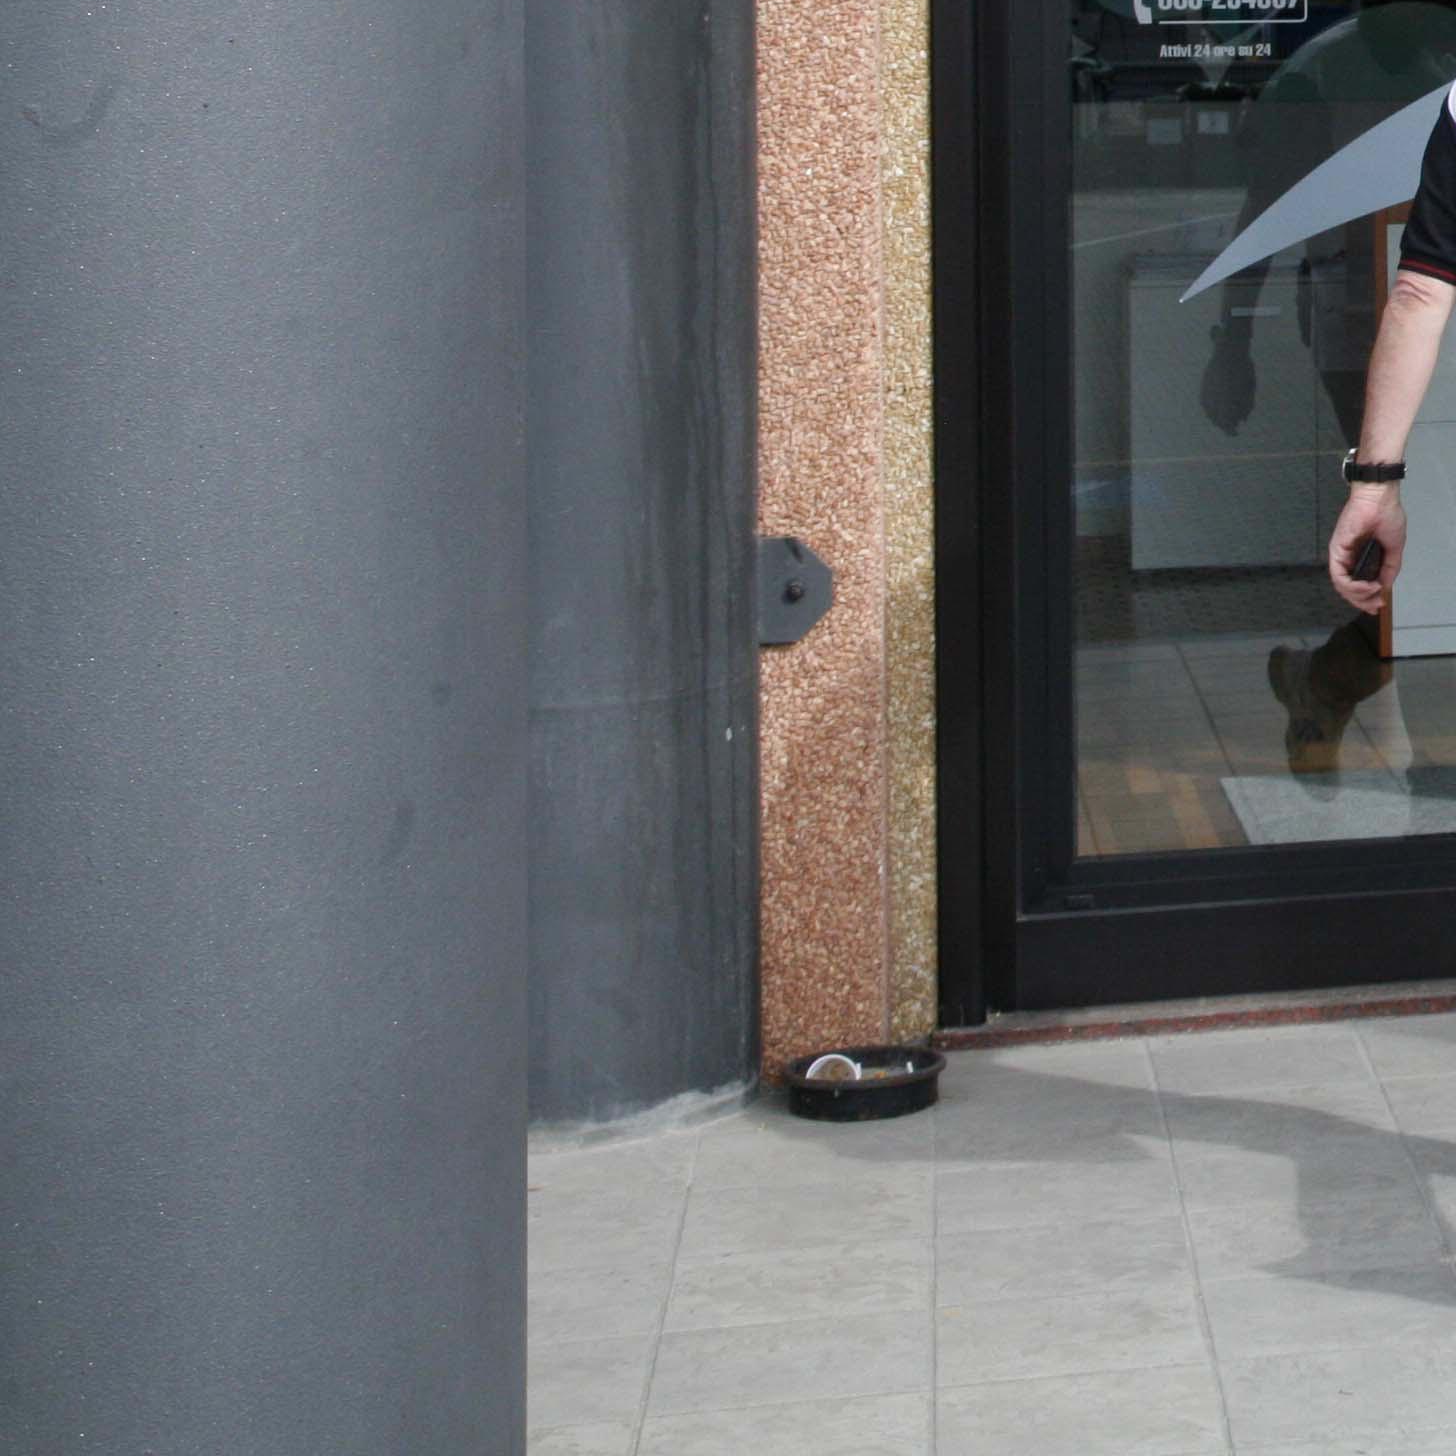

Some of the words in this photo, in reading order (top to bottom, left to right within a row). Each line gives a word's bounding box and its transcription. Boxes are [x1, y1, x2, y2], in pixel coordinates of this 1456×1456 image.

[1159, 44, 1192, 58] Attivi
[1193, 44, 1211, 57] 24
[1212, 45, 1236, 57] ore
[1237, 45, 1254, 57] su
[1255, 44, 1273, 57] 24
